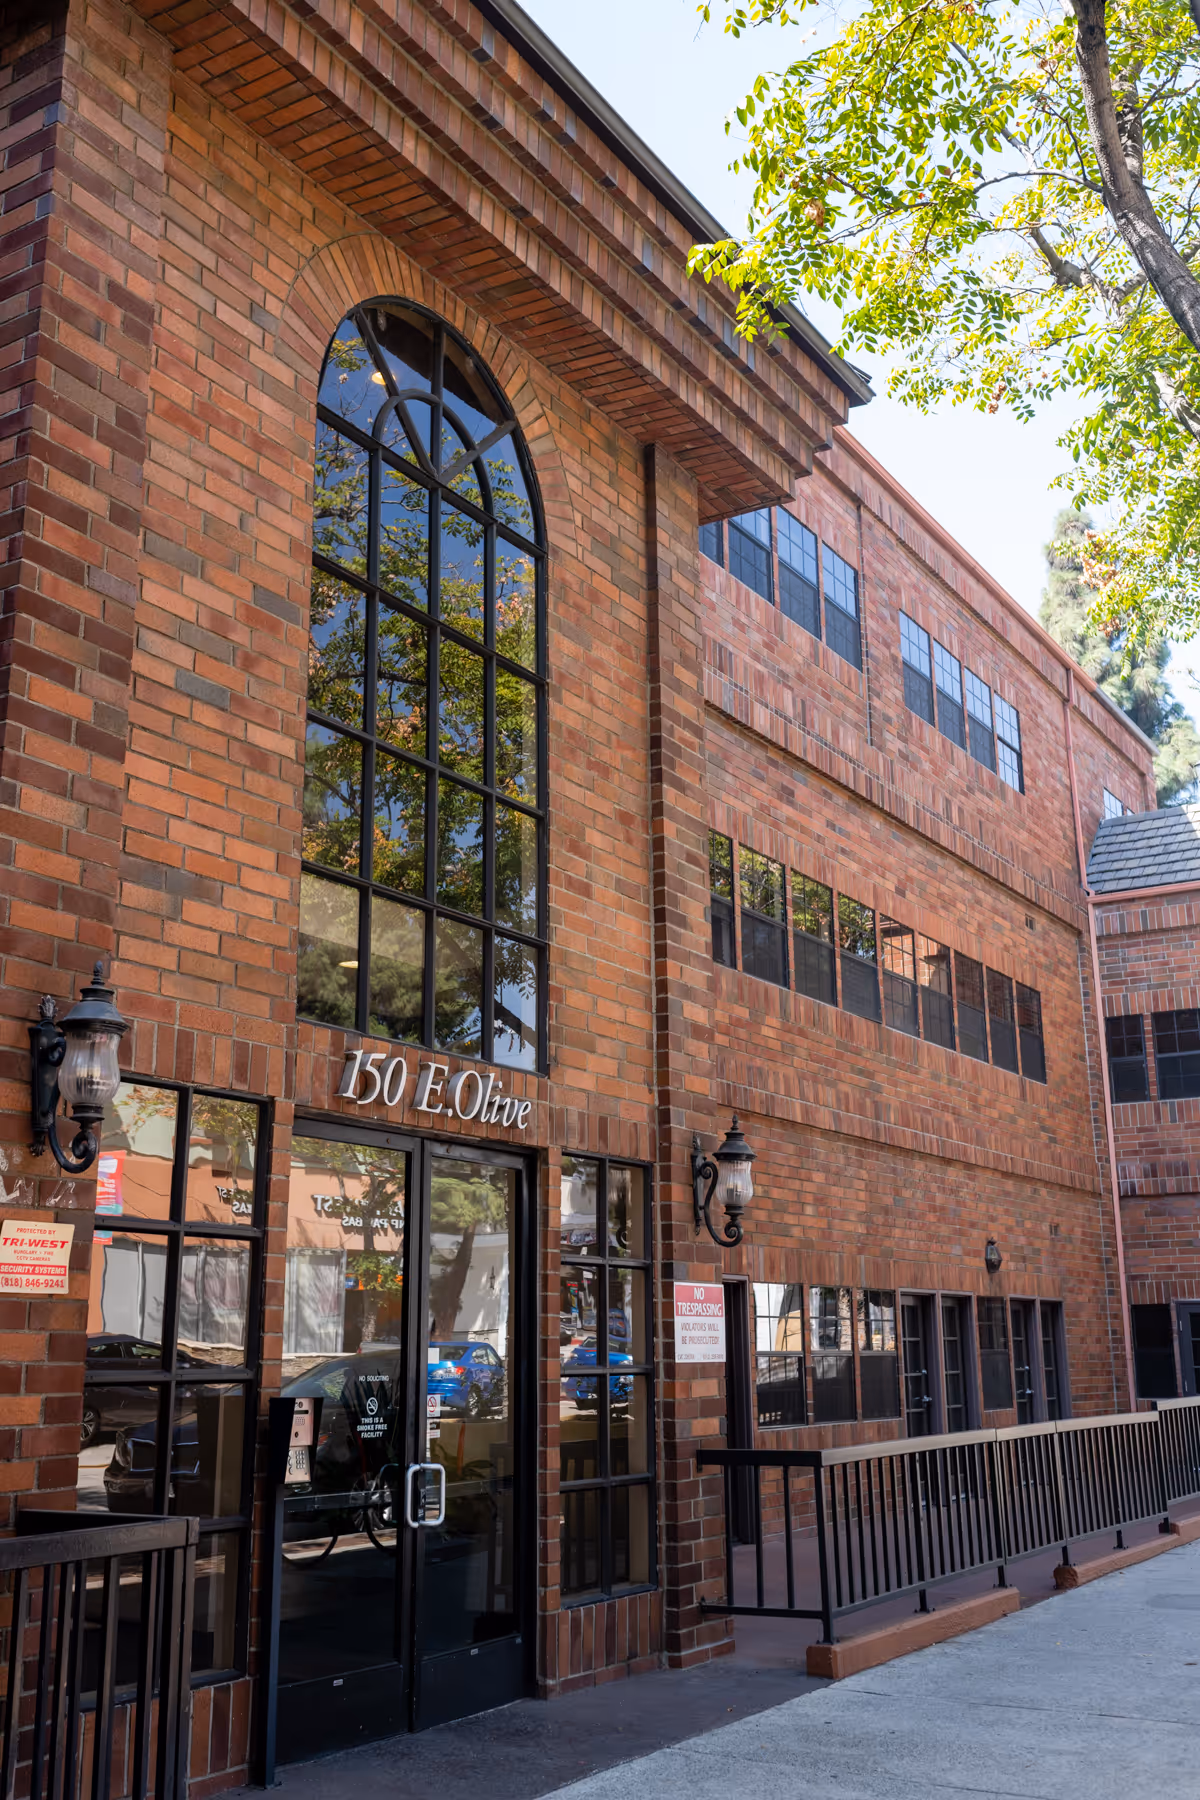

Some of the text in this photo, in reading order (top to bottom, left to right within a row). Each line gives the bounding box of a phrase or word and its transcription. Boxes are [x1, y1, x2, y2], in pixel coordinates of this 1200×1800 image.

[341, 1049, 407, 1106] 150
[2, 1238, 68, 1249] TRI-WEST
[0, 1265, 33, 1273] SECURITY
[0, 1276, 64, 1288] (818) 846-9241
[694, 1287, 704, 1300] NO
[677, 1302, 722, 1316] TRESPASSING
[681, 1323, 719, 1332] VIOLATORS WILL
[682, 1336, 687, 1344] BE
